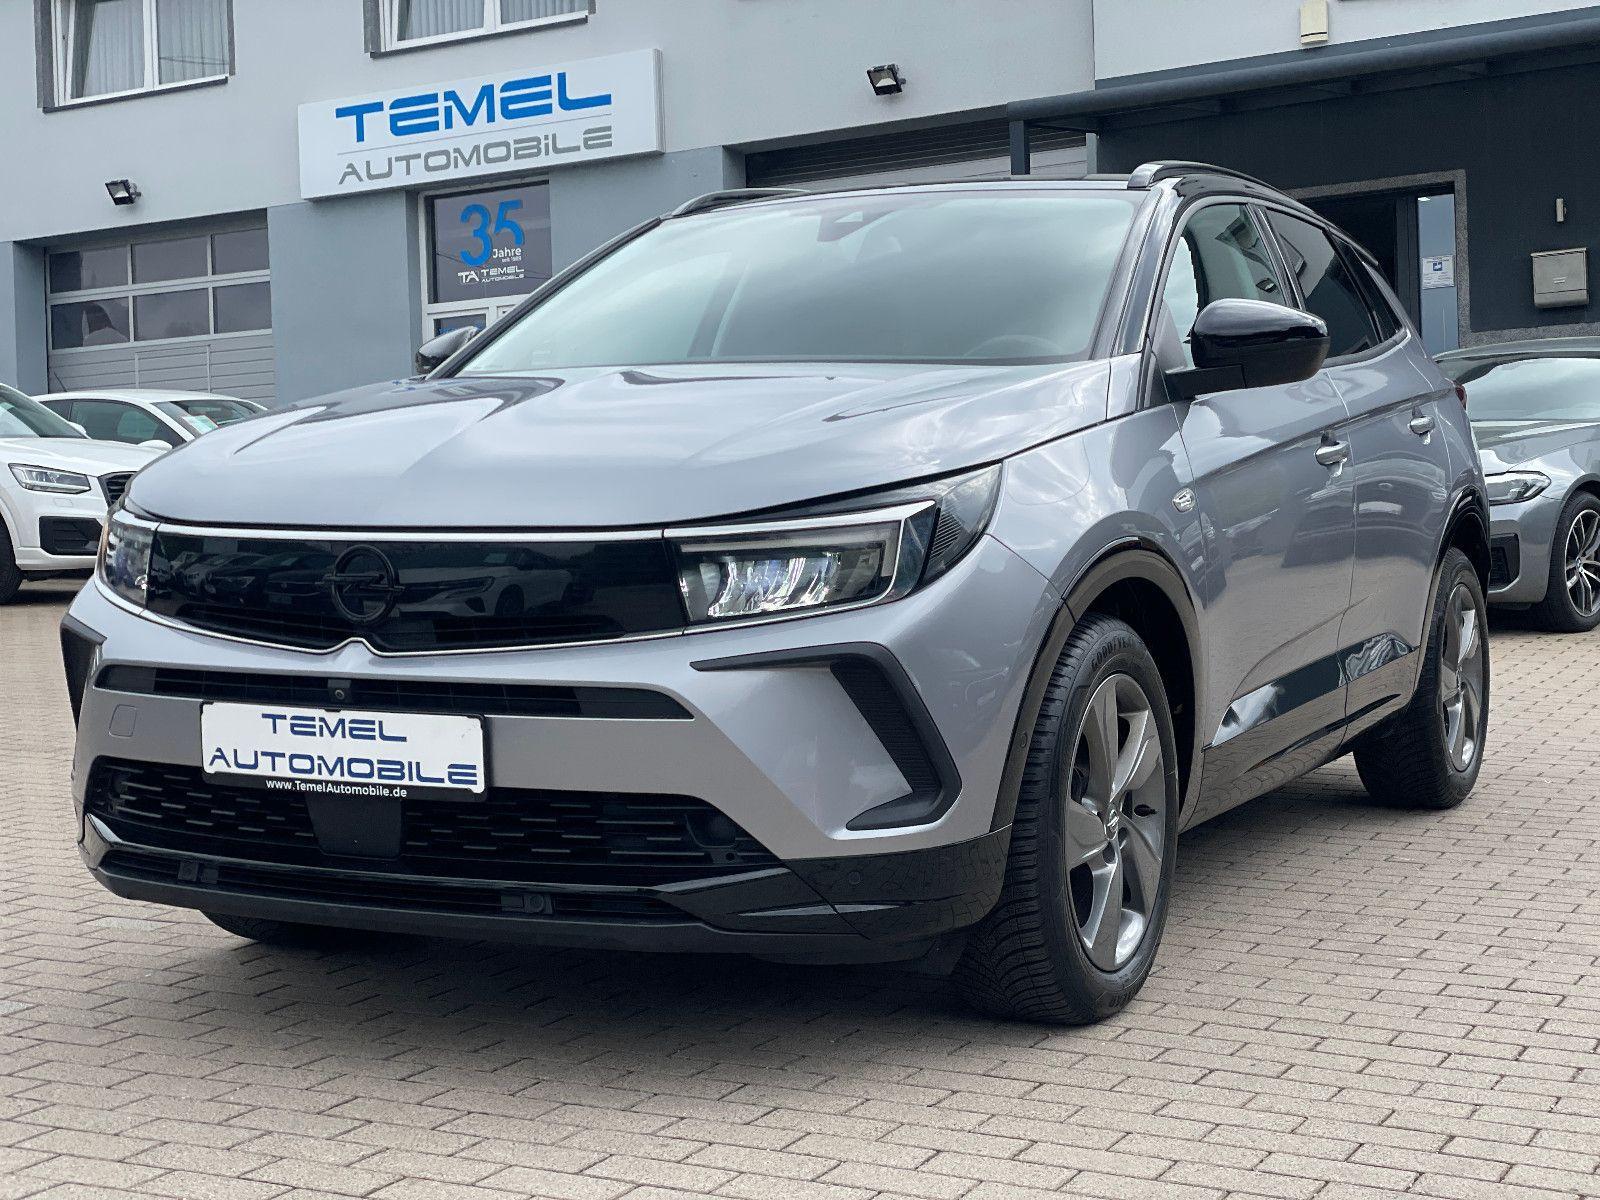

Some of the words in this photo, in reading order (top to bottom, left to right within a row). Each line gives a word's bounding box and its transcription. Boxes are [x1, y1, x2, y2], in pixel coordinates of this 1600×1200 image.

[335, 71, 612, 143] TEMEL
[338, 125, 613, 185] AUTOMOBILE
[459, 199, 525, 267] 35
[492, 246, 522, 259] Jahre
[457, 270, 480, 284] TA
[480, 265, 525, 276] TEMEL
[261, 713, 407, 743] TEMEL
[208, 746, 478, 786] AUTOMOBILE
[265, 779, 408, 798] www.TemelAutomobile.de
